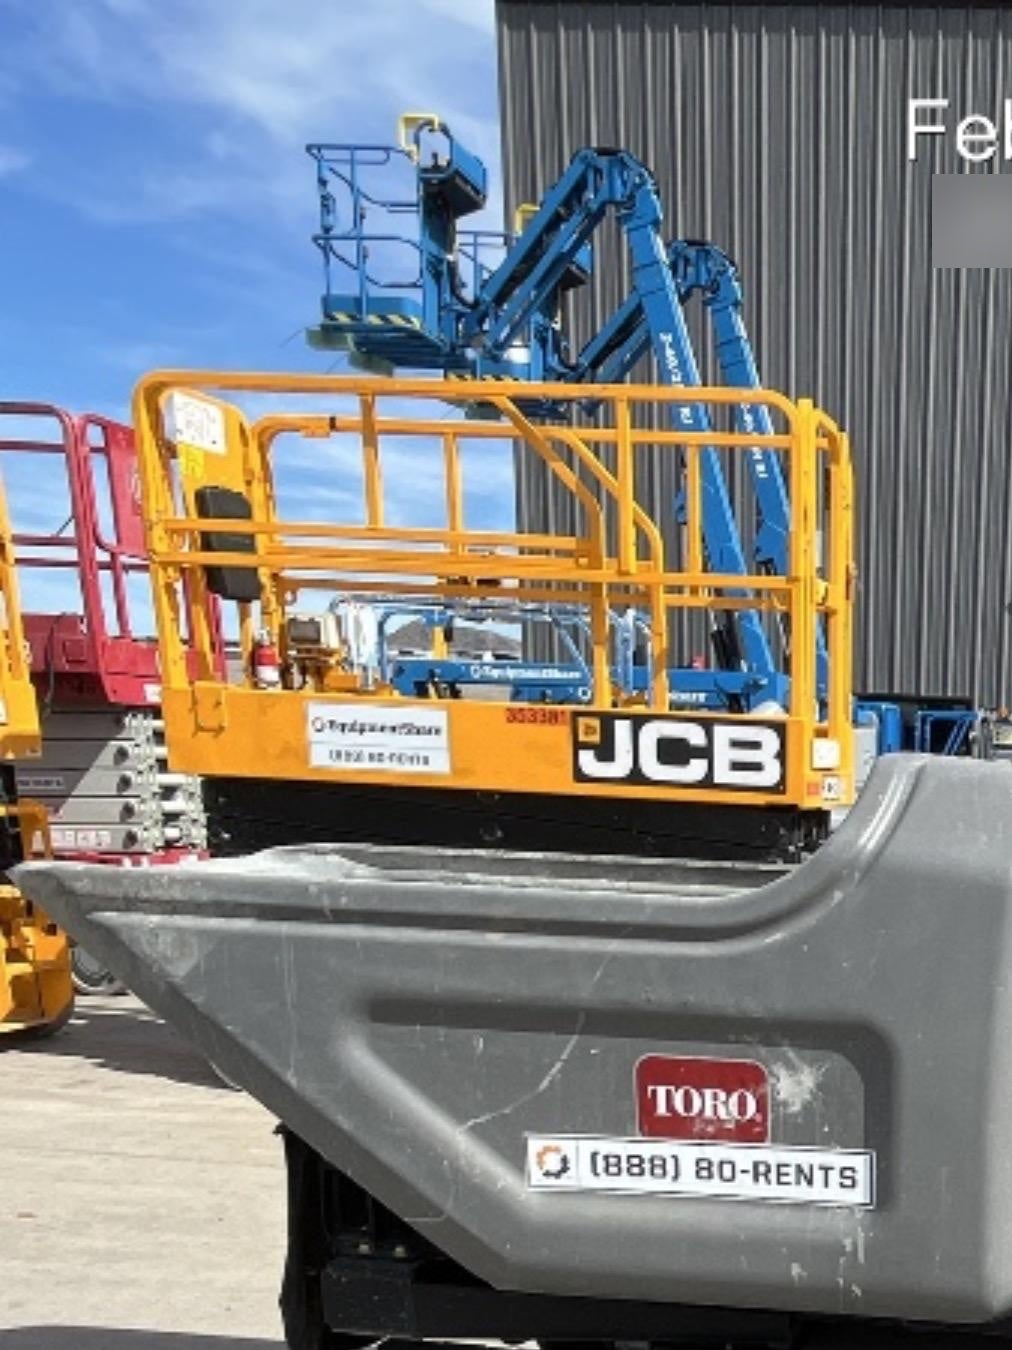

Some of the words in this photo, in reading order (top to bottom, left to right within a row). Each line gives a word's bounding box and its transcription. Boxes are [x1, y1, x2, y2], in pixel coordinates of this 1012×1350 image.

[577, 718, 782, 788] JCB
[647, 1084, 757, 1122] TORO
[590, 1150, 681, 1182] (888)
[694, 1156, 858, 1190] 80-RENTS
